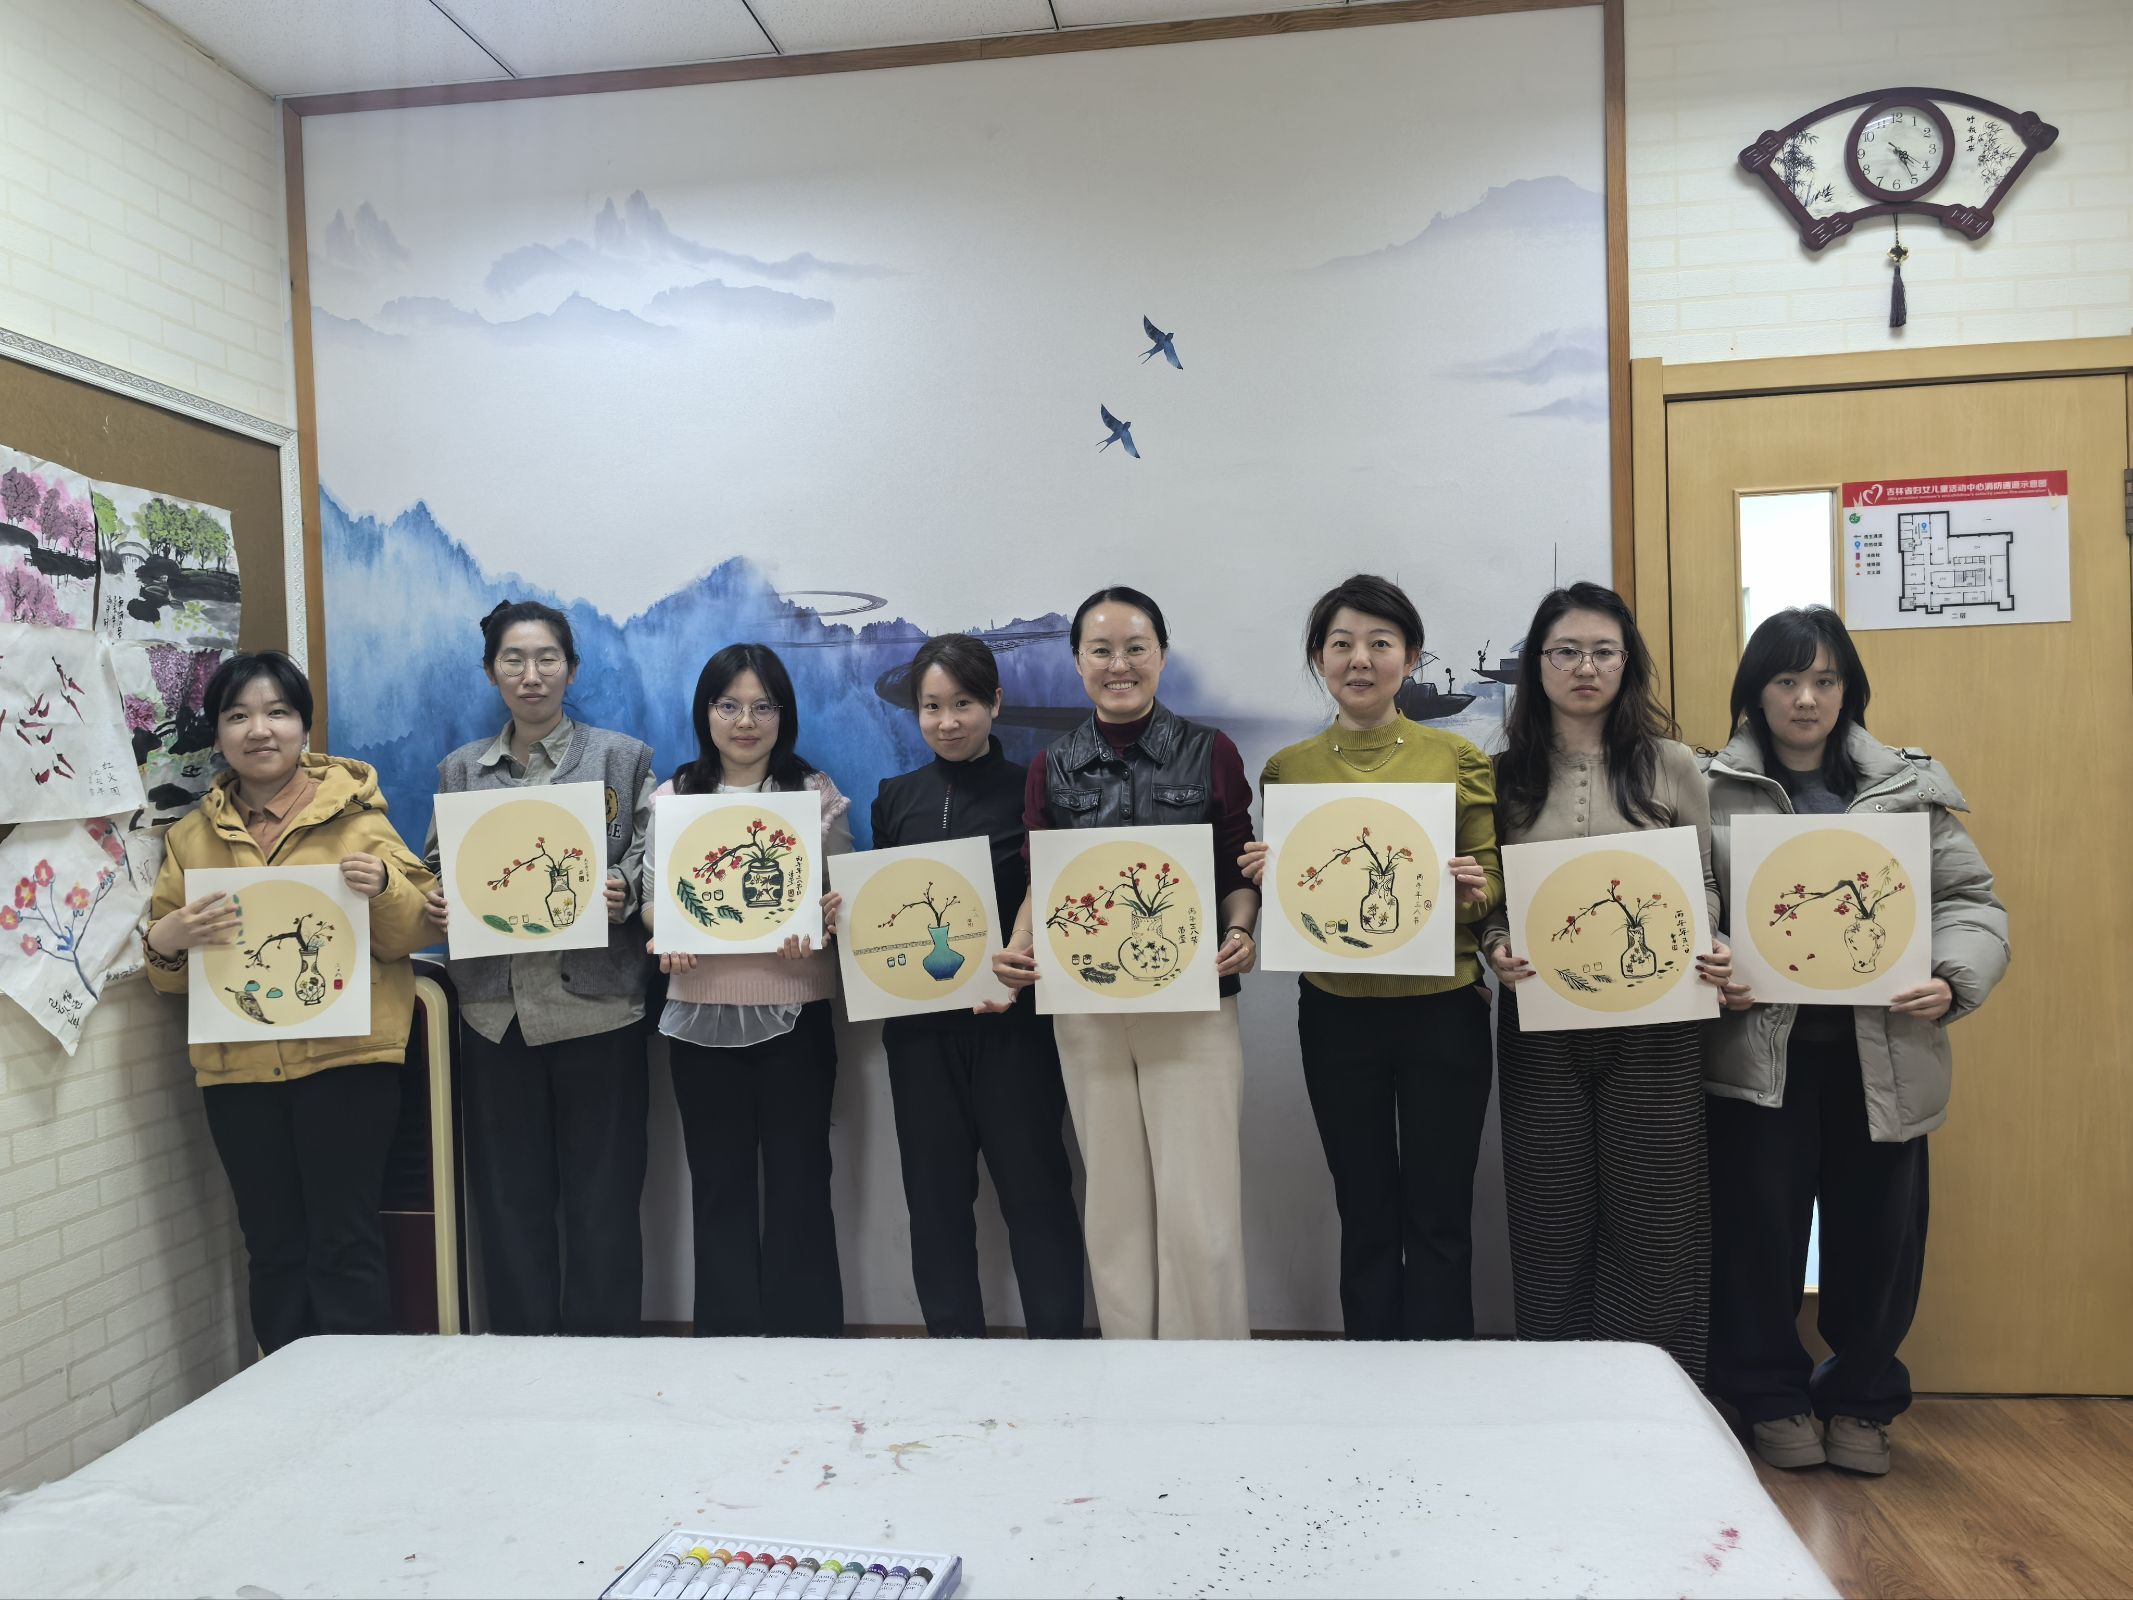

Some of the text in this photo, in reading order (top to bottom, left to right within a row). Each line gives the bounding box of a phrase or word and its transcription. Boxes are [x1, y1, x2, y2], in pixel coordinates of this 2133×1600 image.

[1891, 112, 1903, 124] 12
[1912, 116, 1917, 127] 1
[1863, 131, 1875, 143] 10
[1923, 127, 1931, 138] 2
[1857, 148, 1866, 160] 9
[1928, 143, 1937, 155] 3
[1862, 164, 1871, 175] 8
[1922, 160, 1930, 171] 4
[1876, 176, 1884, 187] 7
[1892, 179, 1901, 190] 6
[1910, 174, 1919, 185] 5
[607, 823, 622, 839] LE
